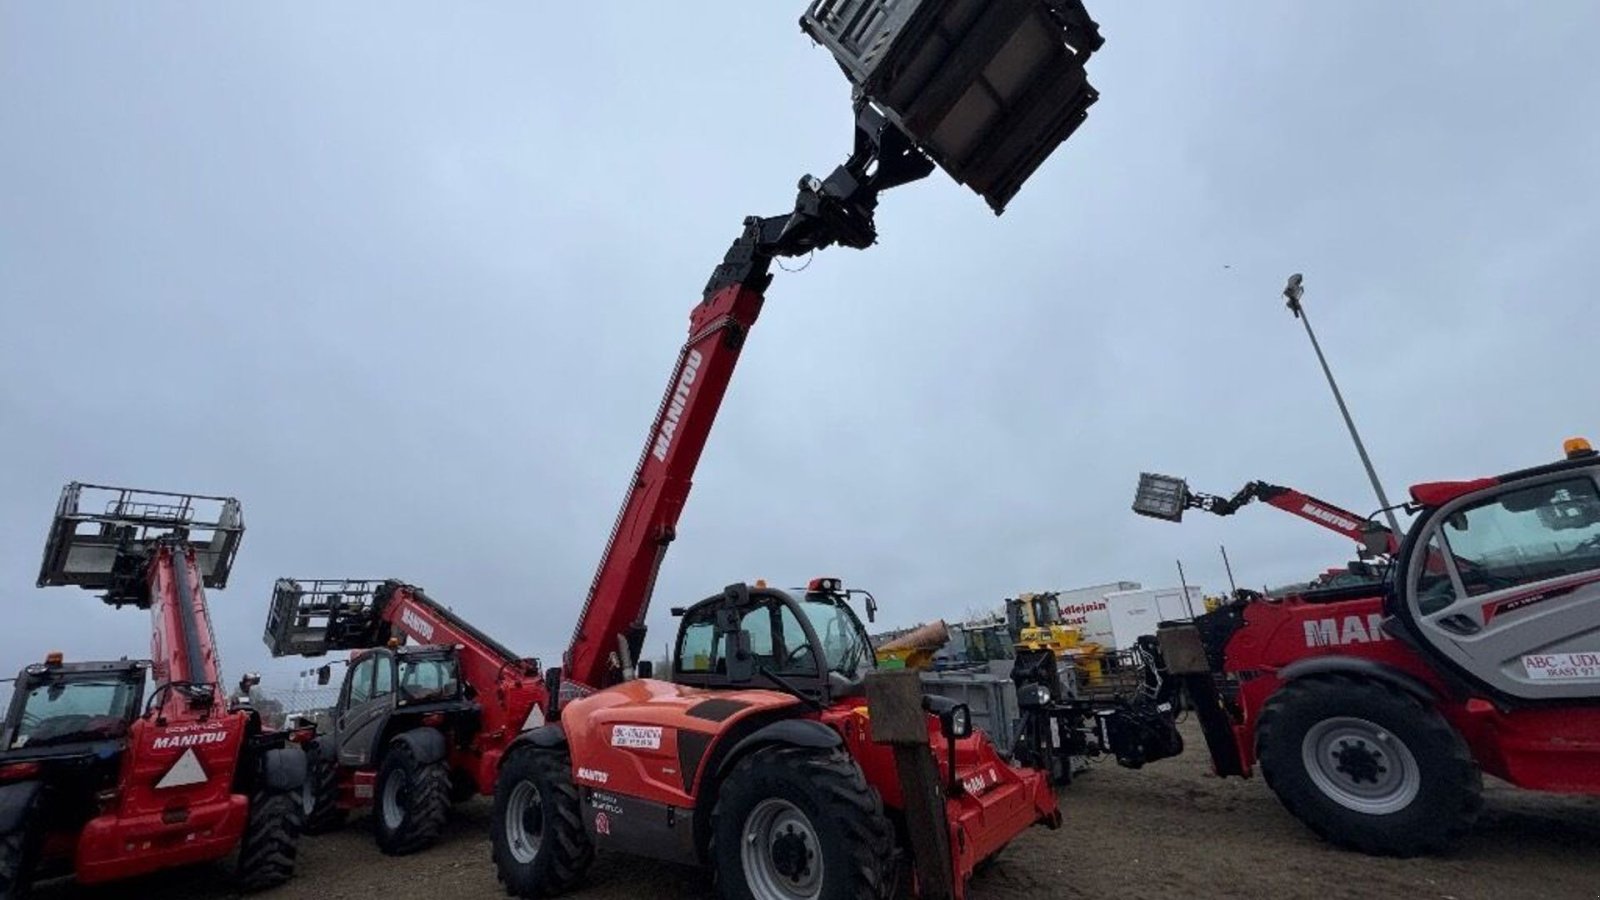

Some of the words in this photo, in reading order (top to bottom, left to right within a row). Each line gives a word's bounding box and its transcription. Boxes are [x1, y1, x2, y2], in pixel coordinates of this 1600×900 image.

[653, 348, 703, 463] MANITOU
[1302, 503, 1358, 531] MANITOU
[401, 607, 434, 641] MANITOU
[1526, 656, 1555, 669] ABC
[153, 732, 228, 750] MANITOU
